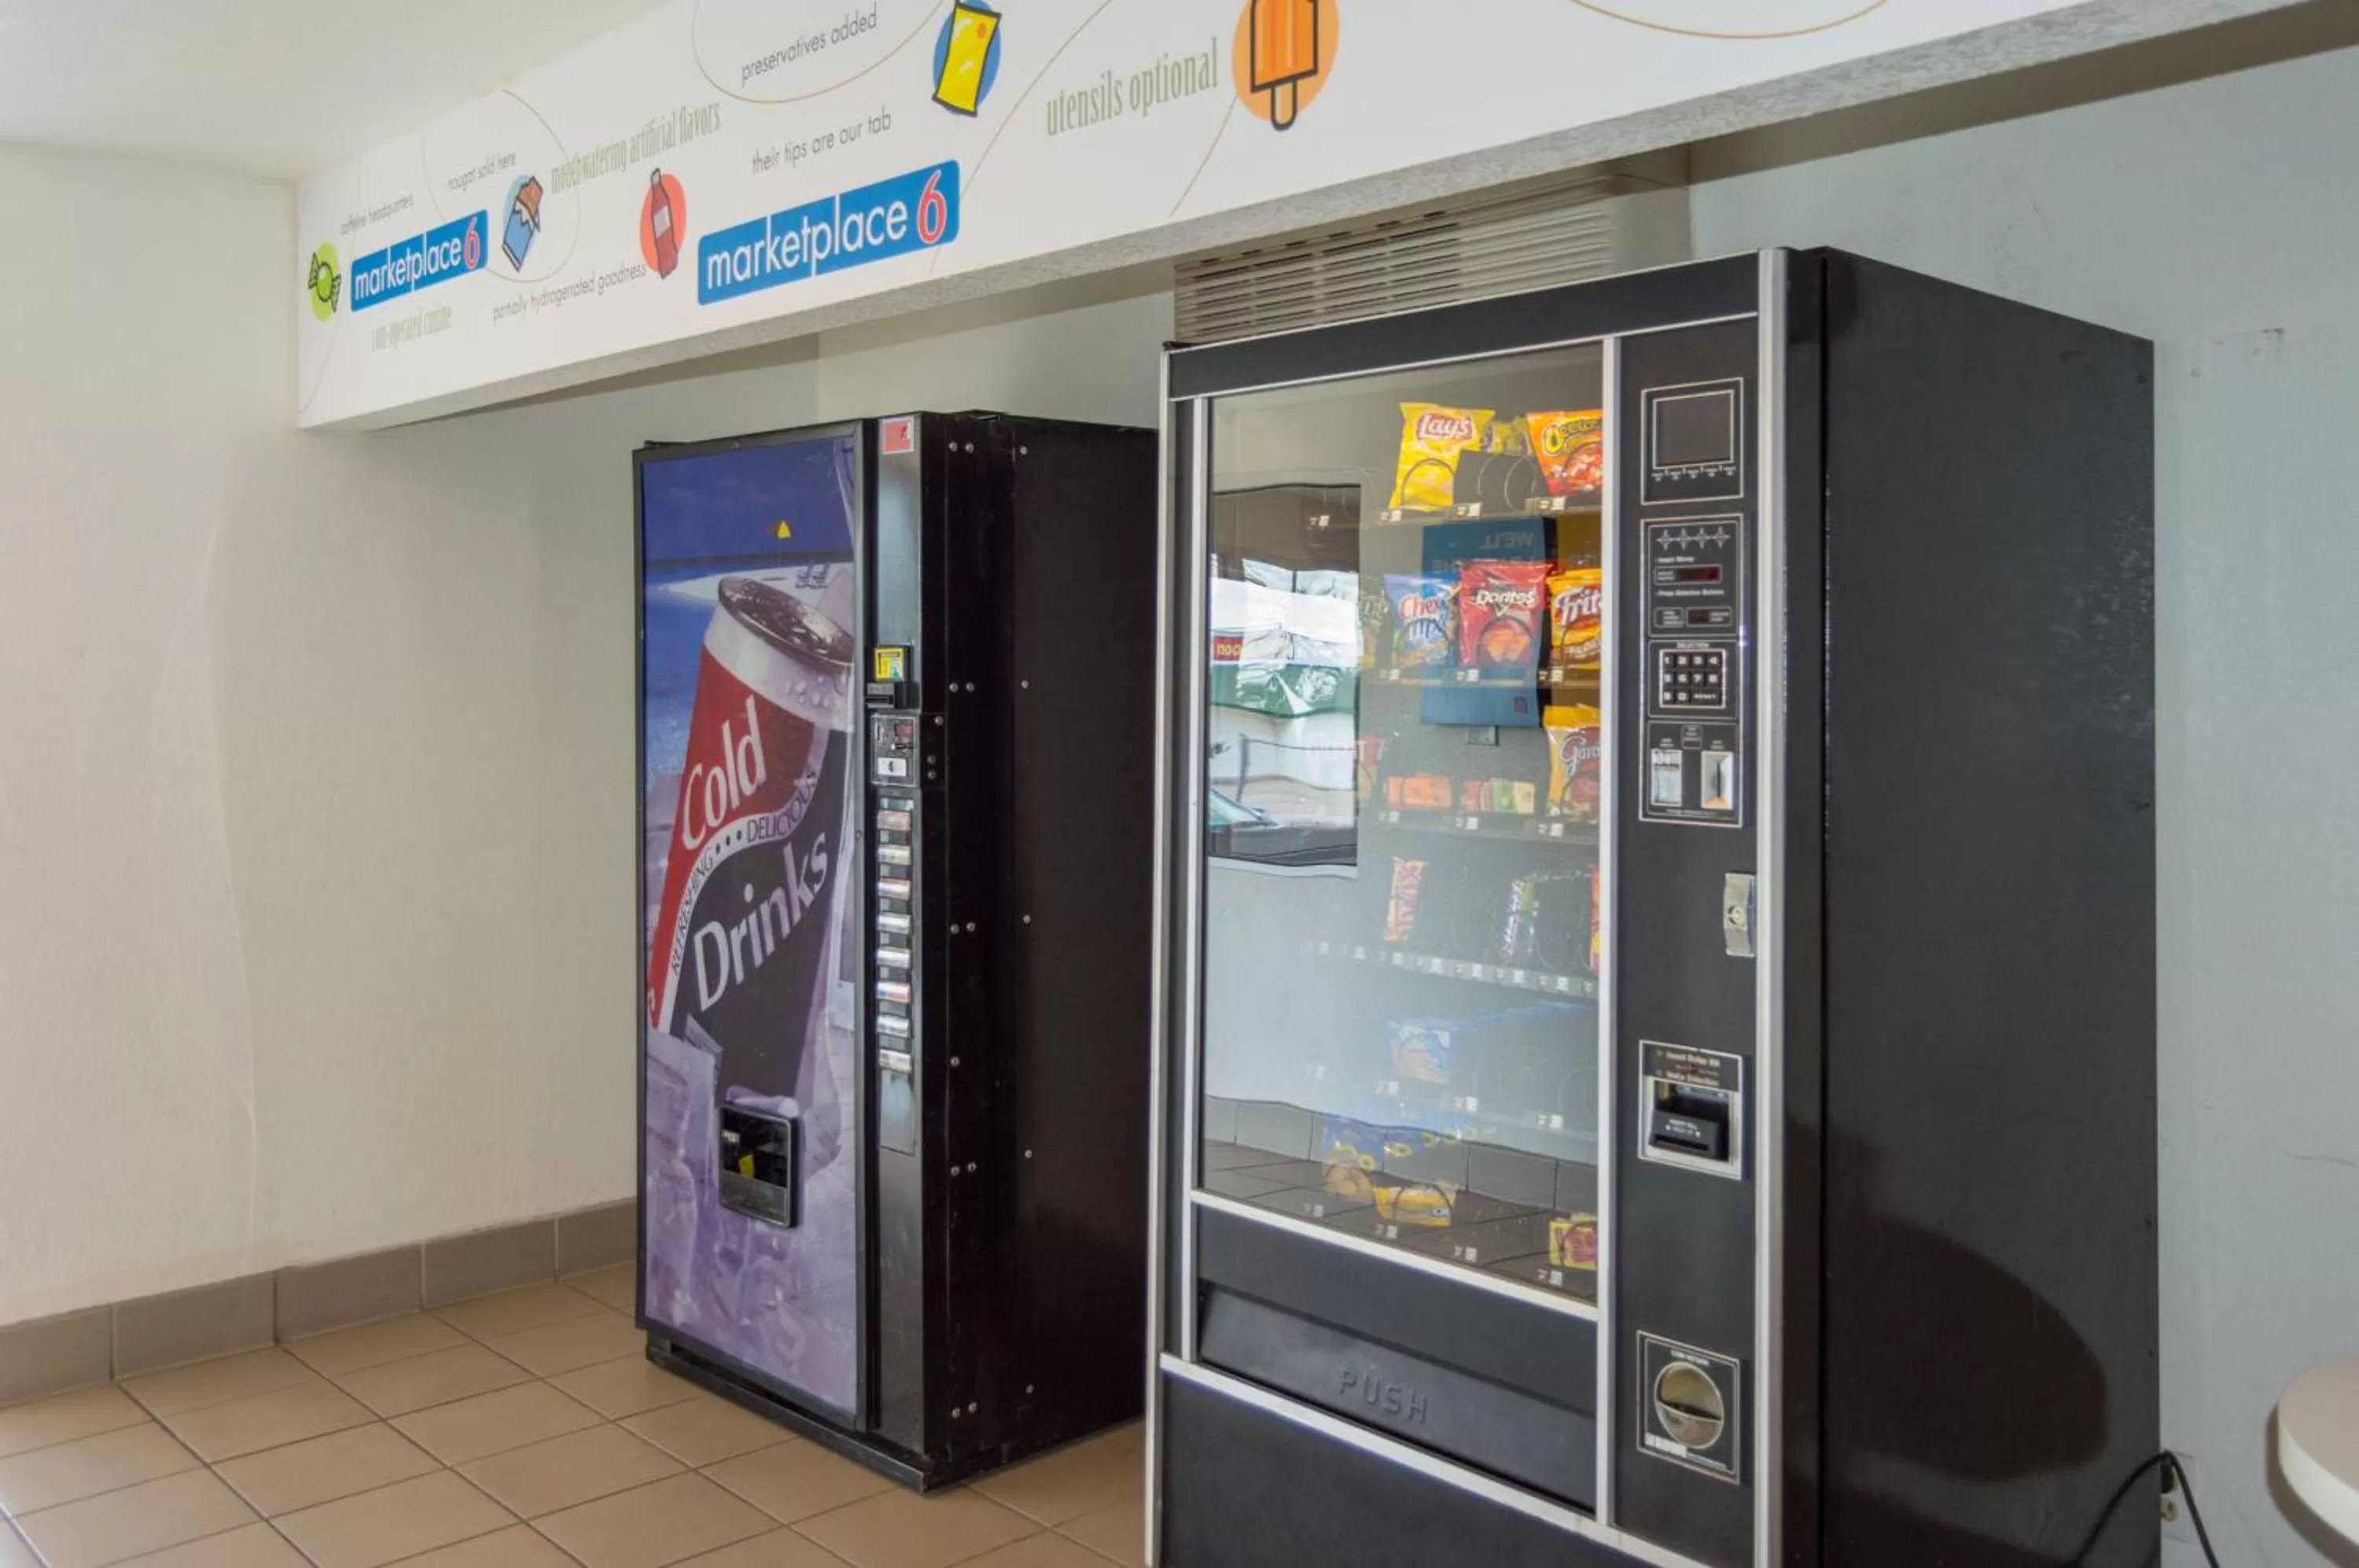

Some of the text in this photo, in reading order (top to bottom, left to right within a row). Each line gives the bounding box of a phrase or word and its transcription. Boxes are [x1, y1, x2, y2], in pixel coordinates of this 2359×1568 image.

[741, 0, 878, 88] preservatives added
[679, 103, 720, 146] flavors
[1047, 37, 1217, 136] utensils optional
[497, 152, 516, 174] here
[752, 105, 891, 175] their tips are our tab
[355, 216, 480, 300] marketplace 6
[707, 169, 948, 289] marketplace 6
[530, 271, 595, 315] hydrogenated
[598, 259, 646, 296] goodness
[1474, 587, 1536, 607] Doritos
[1556, 587, 1602, 627] Frit
[681, 694, 767, 851] Cold
[671, 766, 818, 977] REFRESHING DELICIOUS
[694, 831, 830, 1012] Drinks
[1339, 1370, 1428, 1426] PUSH
